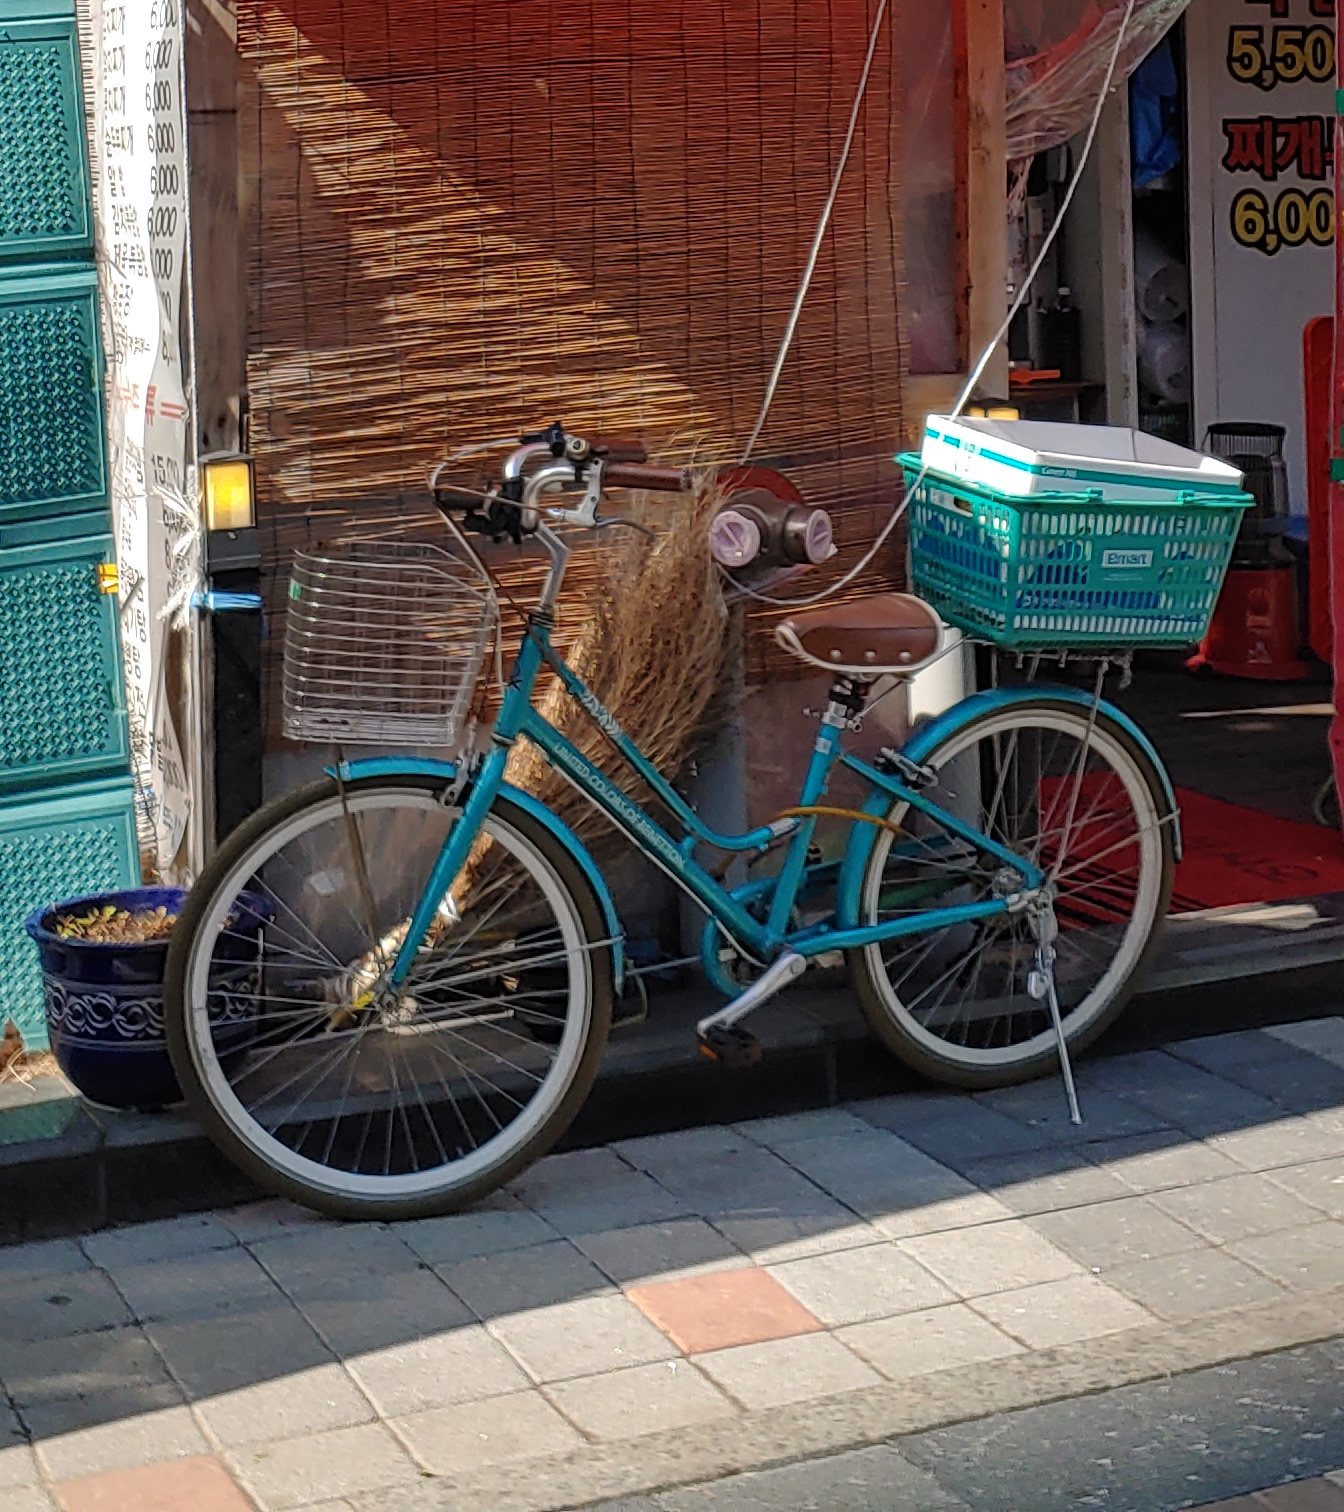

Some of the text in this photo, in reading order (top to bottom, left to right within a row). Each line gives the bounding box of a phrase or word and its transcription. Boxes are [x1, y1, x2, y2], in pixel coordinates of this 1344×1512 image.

[145, 38, 173, 74] 6,000
[145, 80, 172, 117] 6,000
[147, 121, 175, 160] 6,000
[1222, 115, 1336, 182] 찌개
[150, 164, 179, 200] 6,000
[147, 205, 178, 243] 6,000
